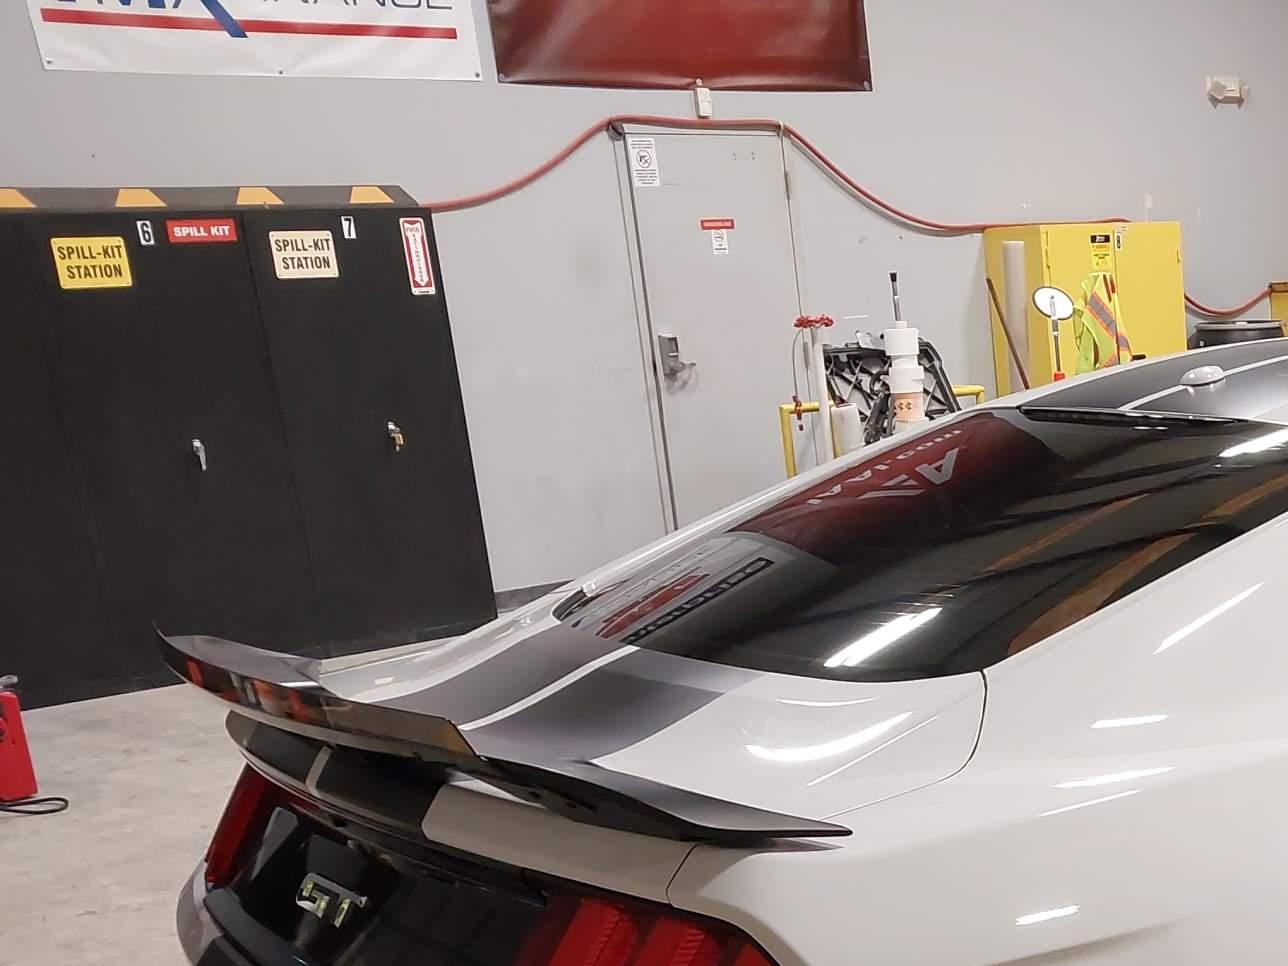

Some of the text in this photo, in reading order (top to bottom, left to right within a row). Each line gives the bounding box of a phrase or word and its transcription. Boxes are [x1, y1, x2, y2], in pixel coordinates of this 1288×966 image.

[140, 222, 151, 243] 6
[173, 225, 230, 237] SPILL KIT
[343, 217, 352, 238] 7
[57, 244, 123, 260] SPILL-KIT
[274, 238, 331, 252] SPILL-KIT
[281, 255, 331, 270] STATION
[67, 263, 123, 280] STATION
[296, 872, 367, 928] GT
